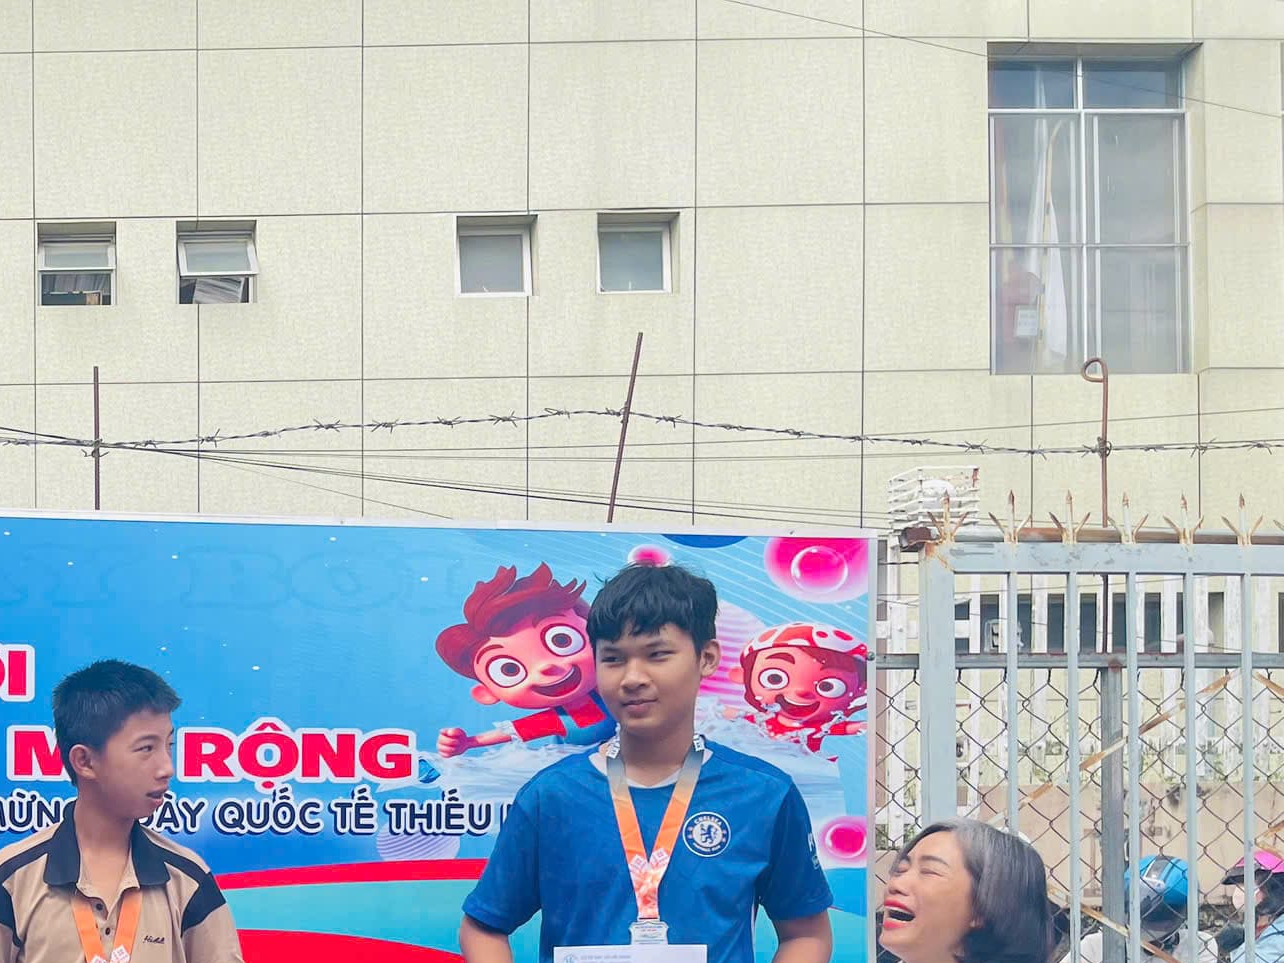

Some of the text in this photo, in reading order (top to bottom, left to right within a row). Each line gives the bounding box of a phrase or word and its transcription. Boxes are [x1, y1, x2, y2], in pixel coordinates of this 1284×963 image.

[182, 720, 414, 790] RỘNG
[217, 786, 322, 831] QUỐC
[332, 786, 376, 830] TẾ
[387, 787, 493, 831] THIẾU
